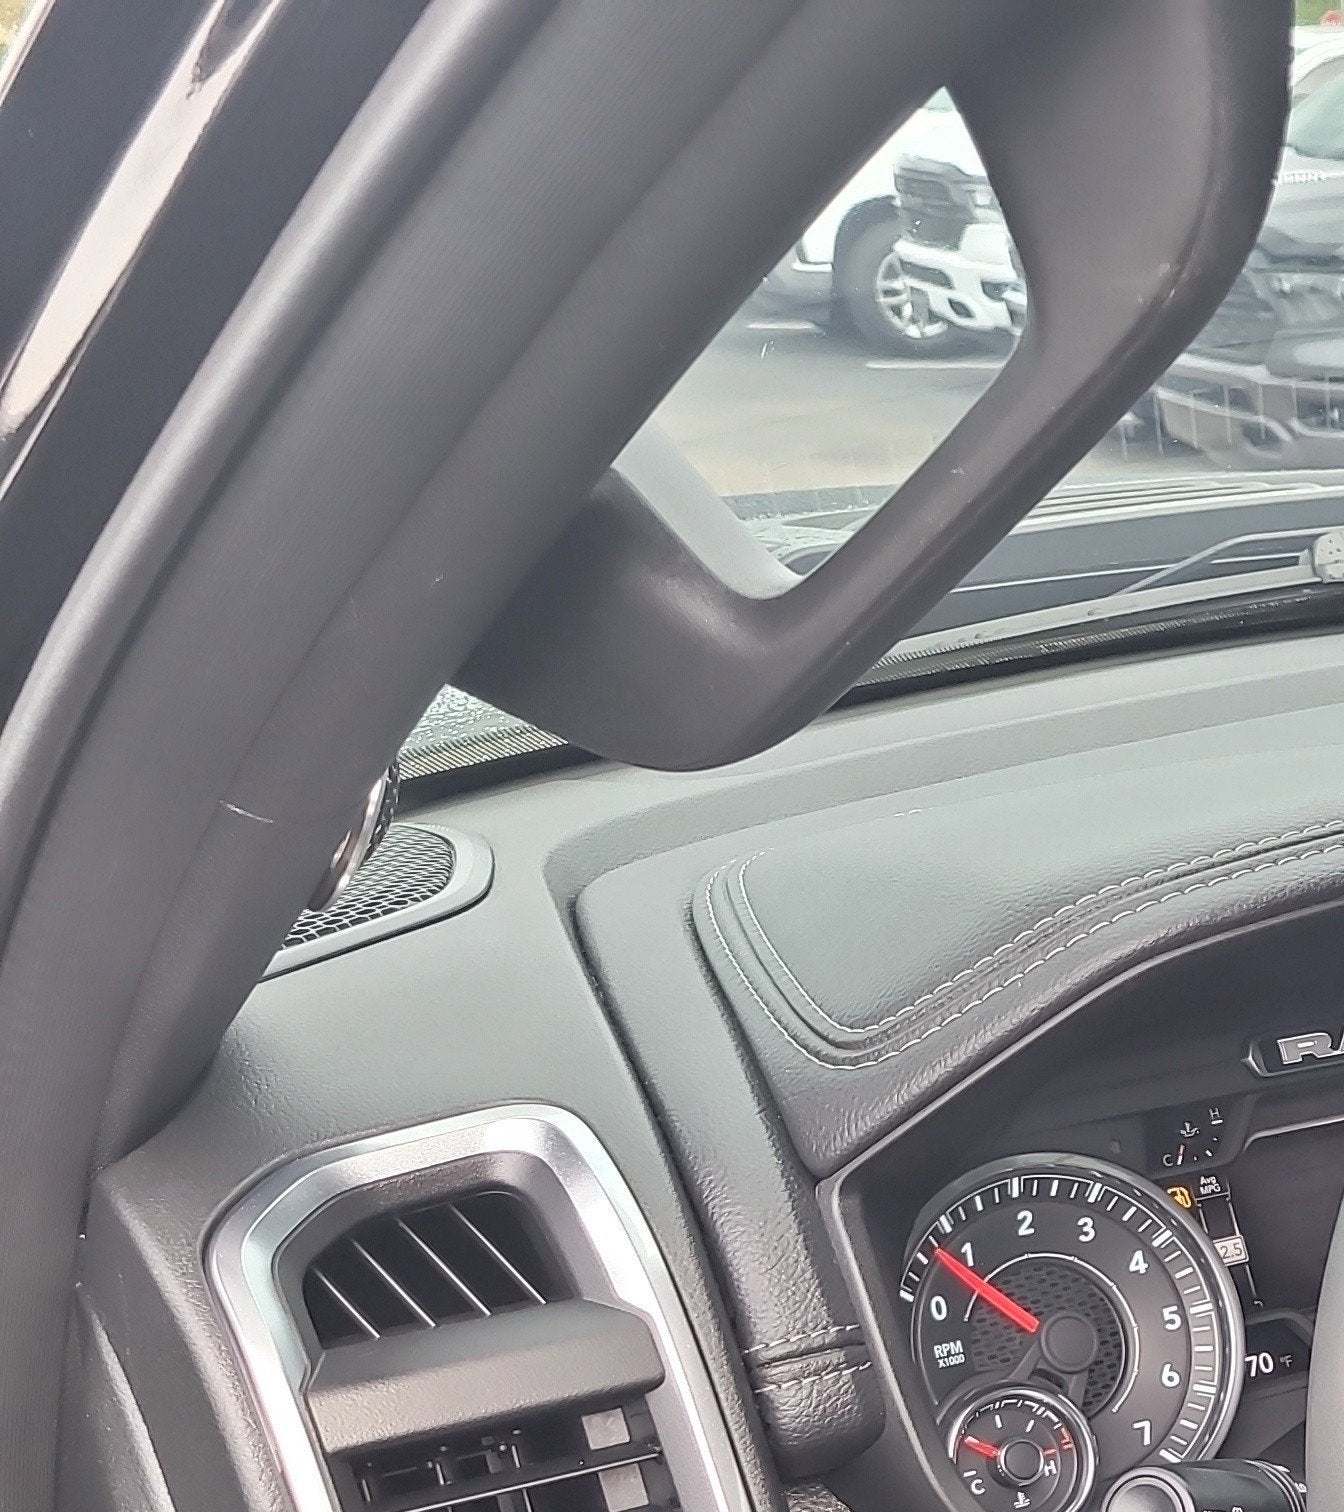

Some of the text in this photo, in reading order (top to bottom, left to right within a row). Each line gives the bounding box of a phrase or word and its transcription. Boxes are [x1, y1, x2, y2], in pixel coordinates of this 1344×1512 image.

[1200, 1184, 1221, 1195] MPG
[1017, 1211, 1035, 1236] 2
[1077, 1217, 1096, 1242] 3
[961, 1242, 974, 1267] 1
[1129, 1250, 1148, 1274] 4
[1220, 1243, 1243, 1260] 2.5
[930, 1296, 947, 1321] 0
[1162, 1306, 1181, 1330] 5
[933, 1340, 964, 1359] RPM
[937, 1354, 965, 1369] X1000
[1161, 1363, 1180, 1387] 6
[1245, 1353, 1274, 1377] 70
[1133, 1420, 1151, 1446] 7
[1044, 1460, 1057, 1477] H
[970, 1479, 986, 1495] C
